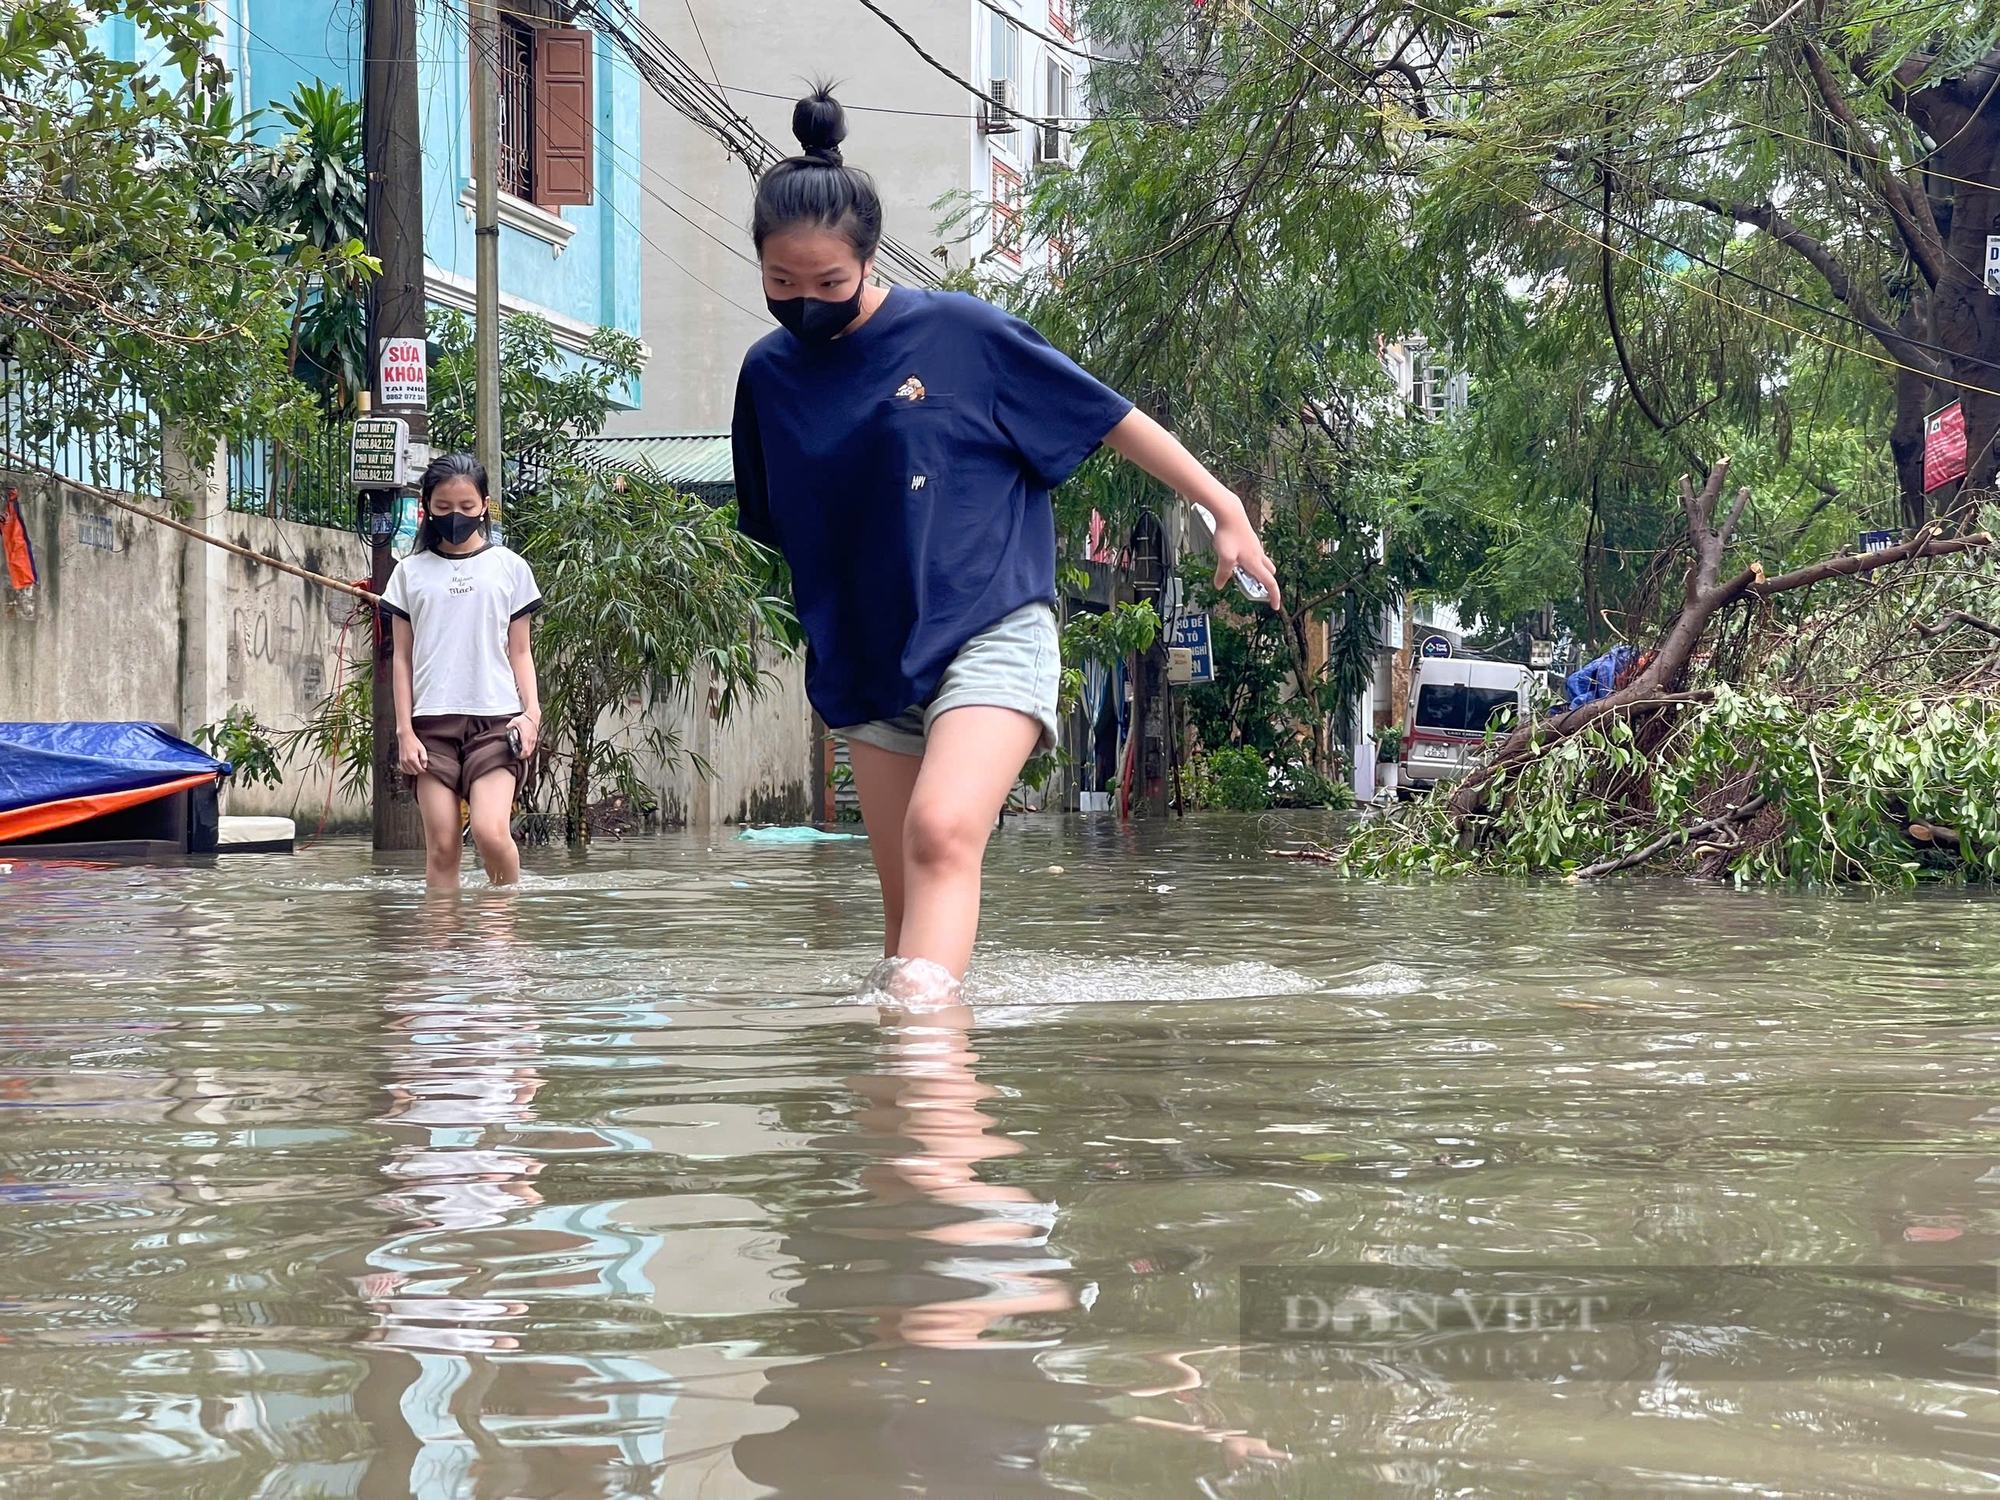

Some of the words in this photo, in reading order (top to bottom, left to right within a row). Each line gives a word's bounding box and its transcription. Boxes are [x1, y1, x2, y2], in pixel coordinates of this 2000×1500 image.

[388, 341, 420, 362] SỬA
[384, 364, 424, 382] KHÓA
[357, 423, 369, 433] CHO
[370, 423, 380, 433] VAY
[355, 439, 394, 449] 0366.842.122
[355, 454, 368, 464] CHO
[368, 454, 379, 464] VAY
[354, 470, 393, 481] 0366.842.122
[449, 585, 475, 594] Black
